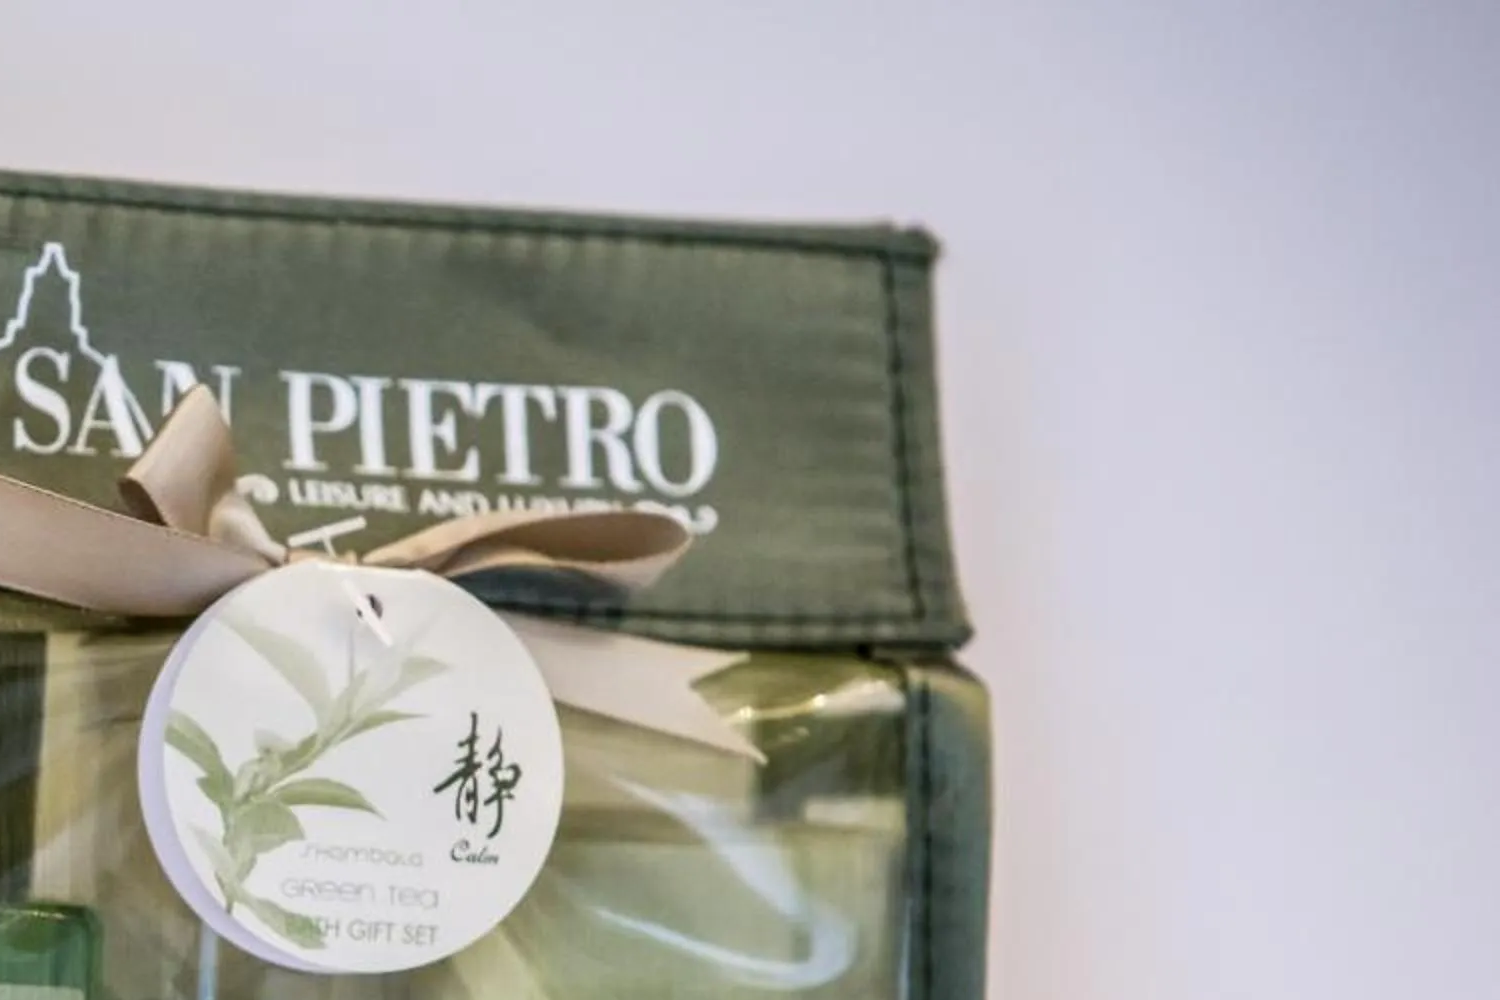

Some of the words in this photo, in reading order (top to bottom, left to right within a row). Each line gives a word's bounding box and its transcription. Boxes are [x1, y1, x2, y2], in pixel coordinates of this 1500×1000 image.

[13, 346, 242, 458] SAN
[278, 369, 718, 497] PIETRO
[289, 478, 409, 513] LEISURE
[419, 488, 489, 517] AND
[449, 840, 500, 865] Calm
[347, 918, 396, 944] GIFT
[402, 923, 440, 946] SET
